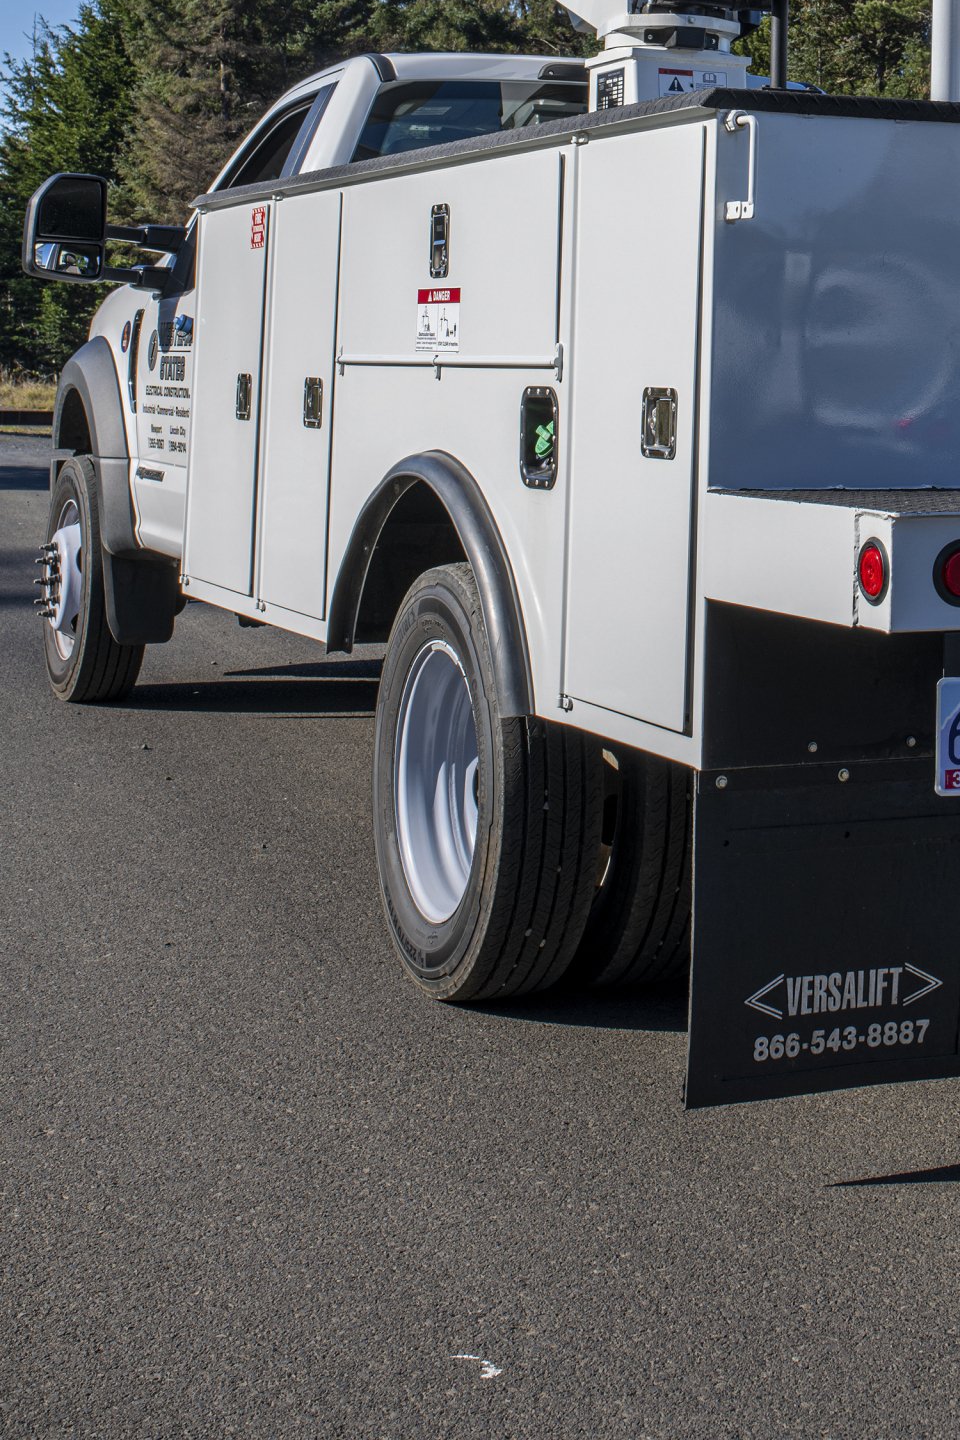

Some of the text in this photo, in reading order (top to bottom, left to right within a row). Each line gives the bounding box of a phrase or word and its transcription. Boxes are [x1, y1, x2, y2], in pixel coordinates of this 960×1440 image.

[433, 290, 451, 301] DANGER
[160, 355, 186, 381] STATES
[786, 966, 903, 1017] VERSALIFT
[753, 1019, 930, 1062] 866-543-8887
